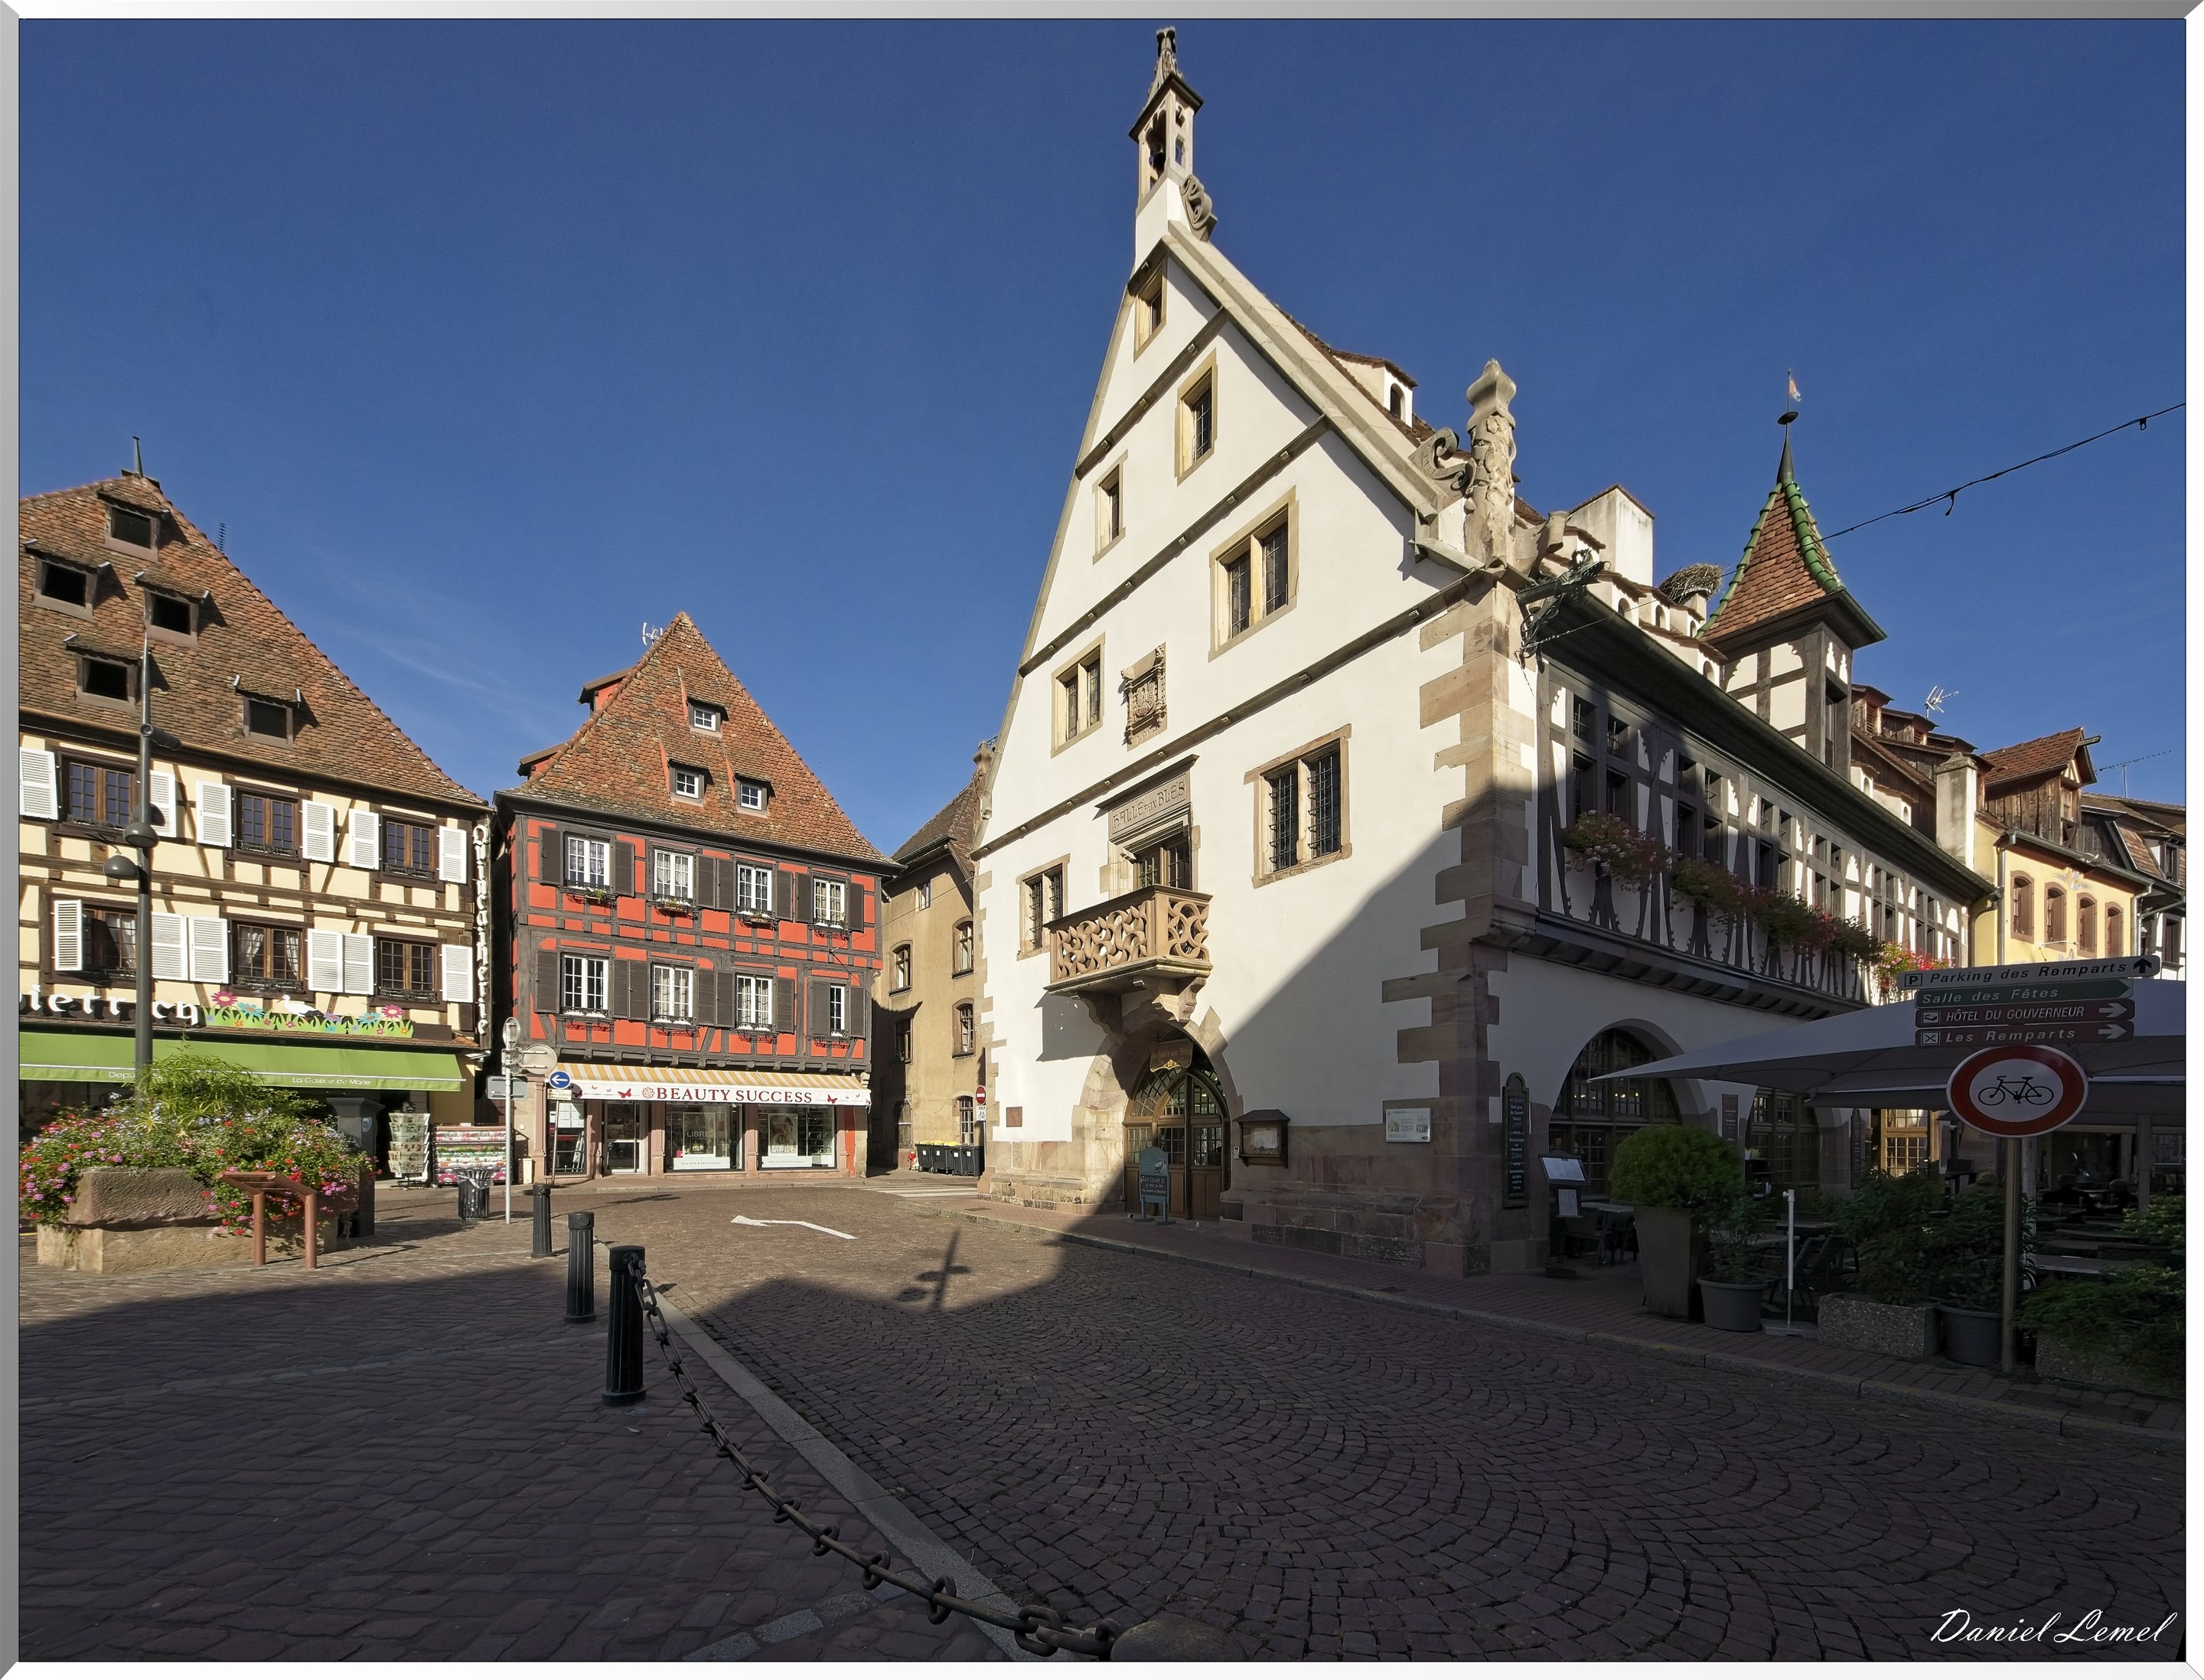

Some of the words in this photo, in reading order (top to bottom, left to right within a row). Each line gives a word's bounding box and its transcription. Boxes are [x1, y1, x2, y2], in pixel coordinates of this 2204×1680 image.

[1930, 972, 1993, 983] Parking
[2000, 969, 2029, 980] des
[2039, 963, 2127, 977] Remparts
[1922, 993, 1961, 1004] Salle
[1972, 992, 2000, 1001] des
[2011, 989, 2059, 1000] Fêtes
[19, 984, 197, 1026] ietrch
[1946, 1009, 1979, 1022] HÔTEL
[1985, 1010, 2002, 1019] DU
[2007, 1006, 2085, 1019] GOUVERNEUR
[1946, 1032, 1973, 1042] Les
[1986, 1029, 2075, 1042] Remparts
[657, 1088, 730, 1101] BEAUTY
[735, 1090, 813, 1103] SUCCESS
